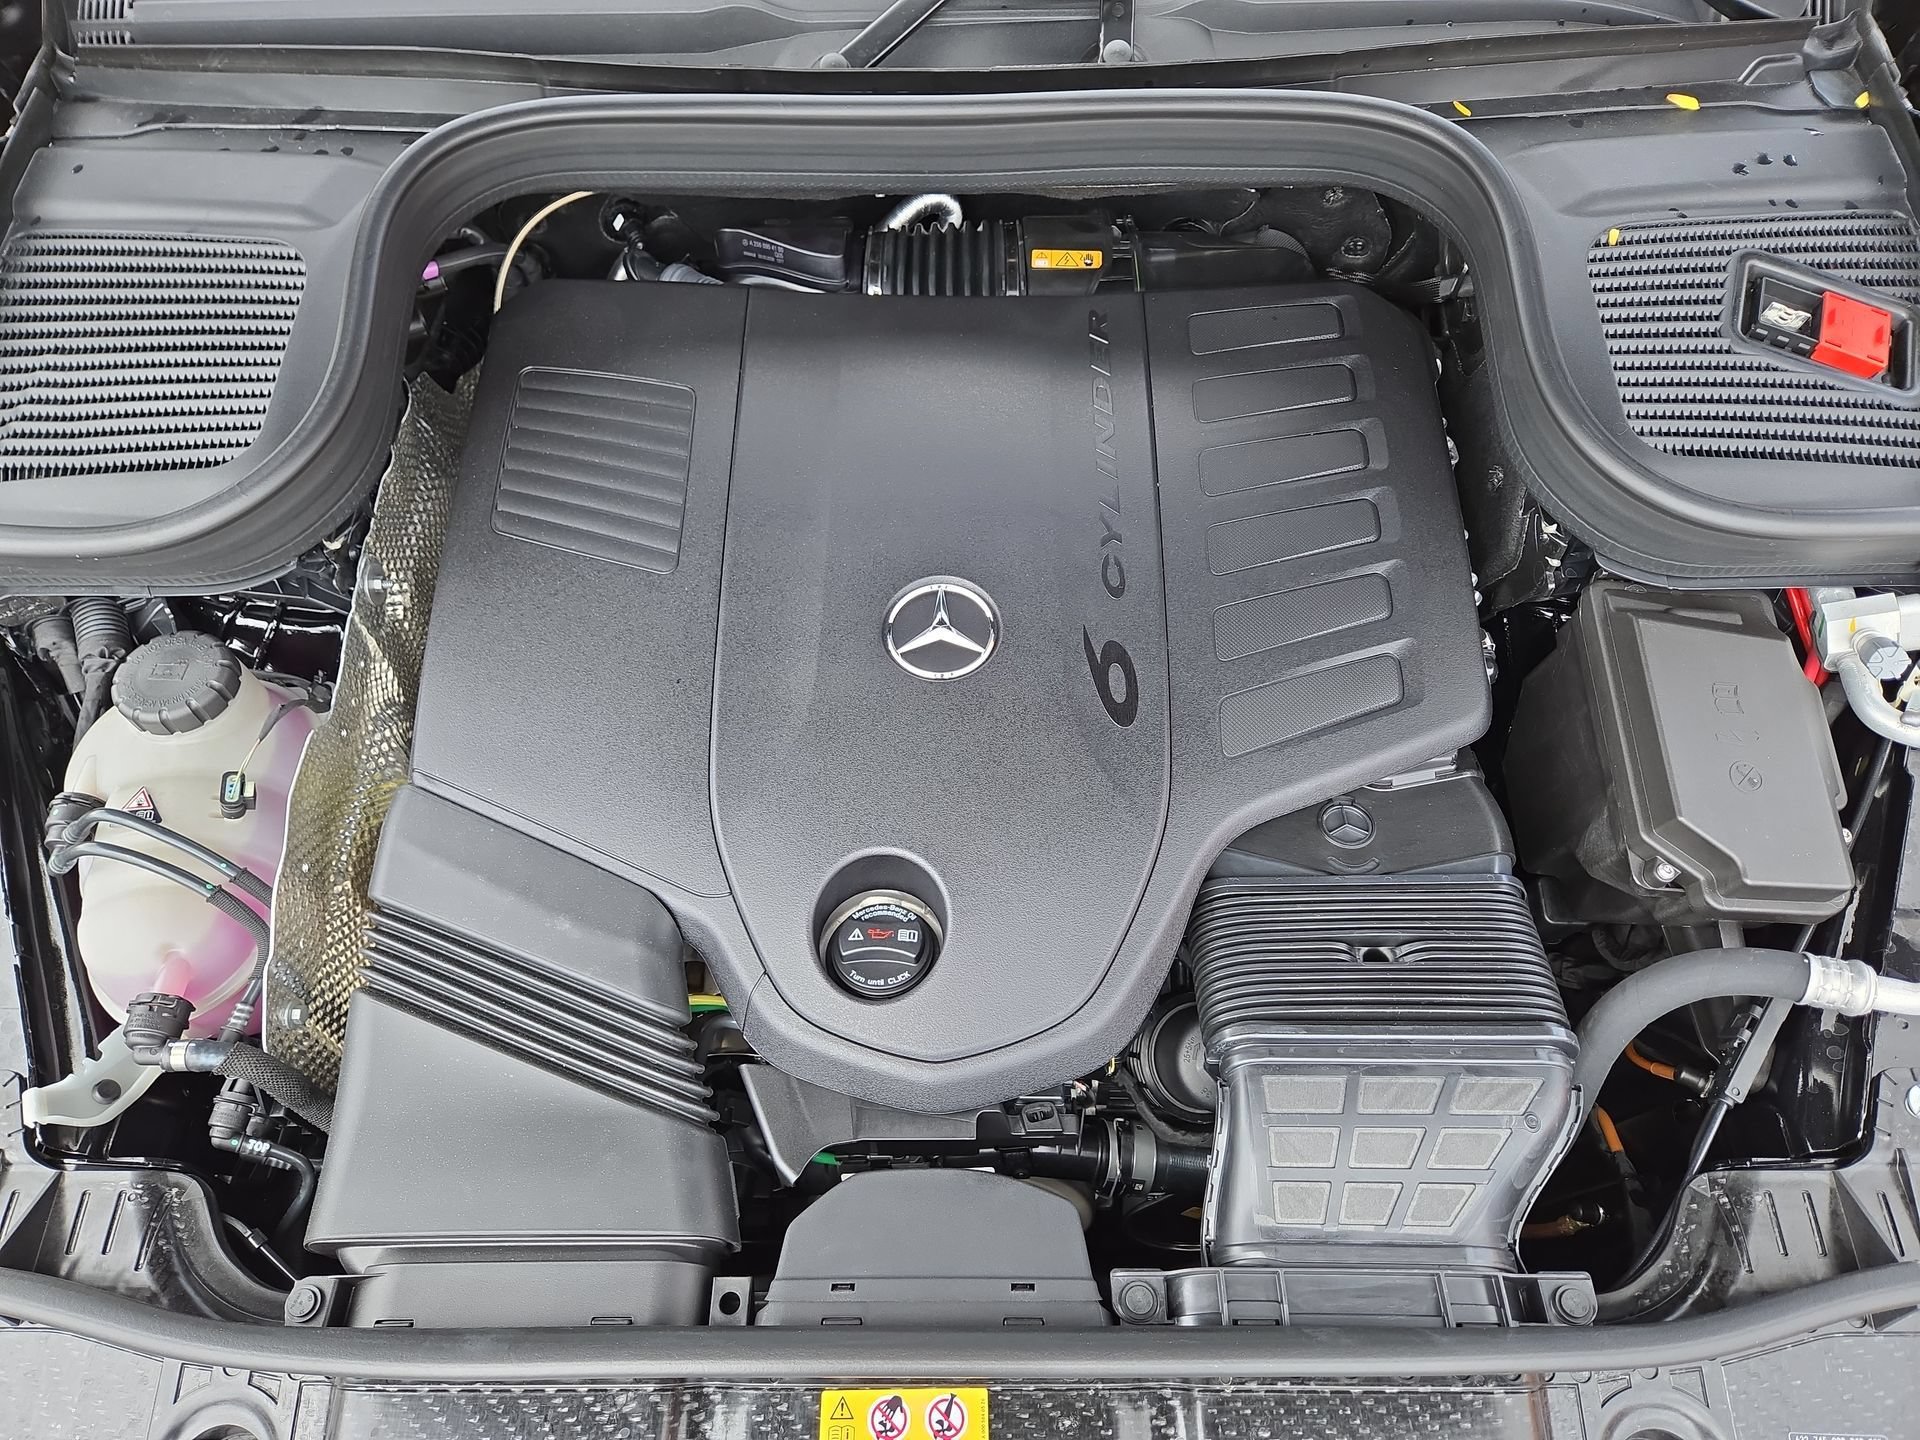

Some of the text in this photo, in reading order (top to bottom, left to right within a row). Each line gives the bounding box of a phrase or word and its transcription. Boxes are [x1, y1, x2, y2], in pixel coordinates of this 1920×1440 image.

[1083, 308, 1139, 728] 6 CYLINDER
[852, 904, 907, 920] Mercedes-Benz
[860, 909, 909, 922] recommended
[849, 969, 912, 986] Turn until CLICK
[248, 1138, 271, 1153] TOP
